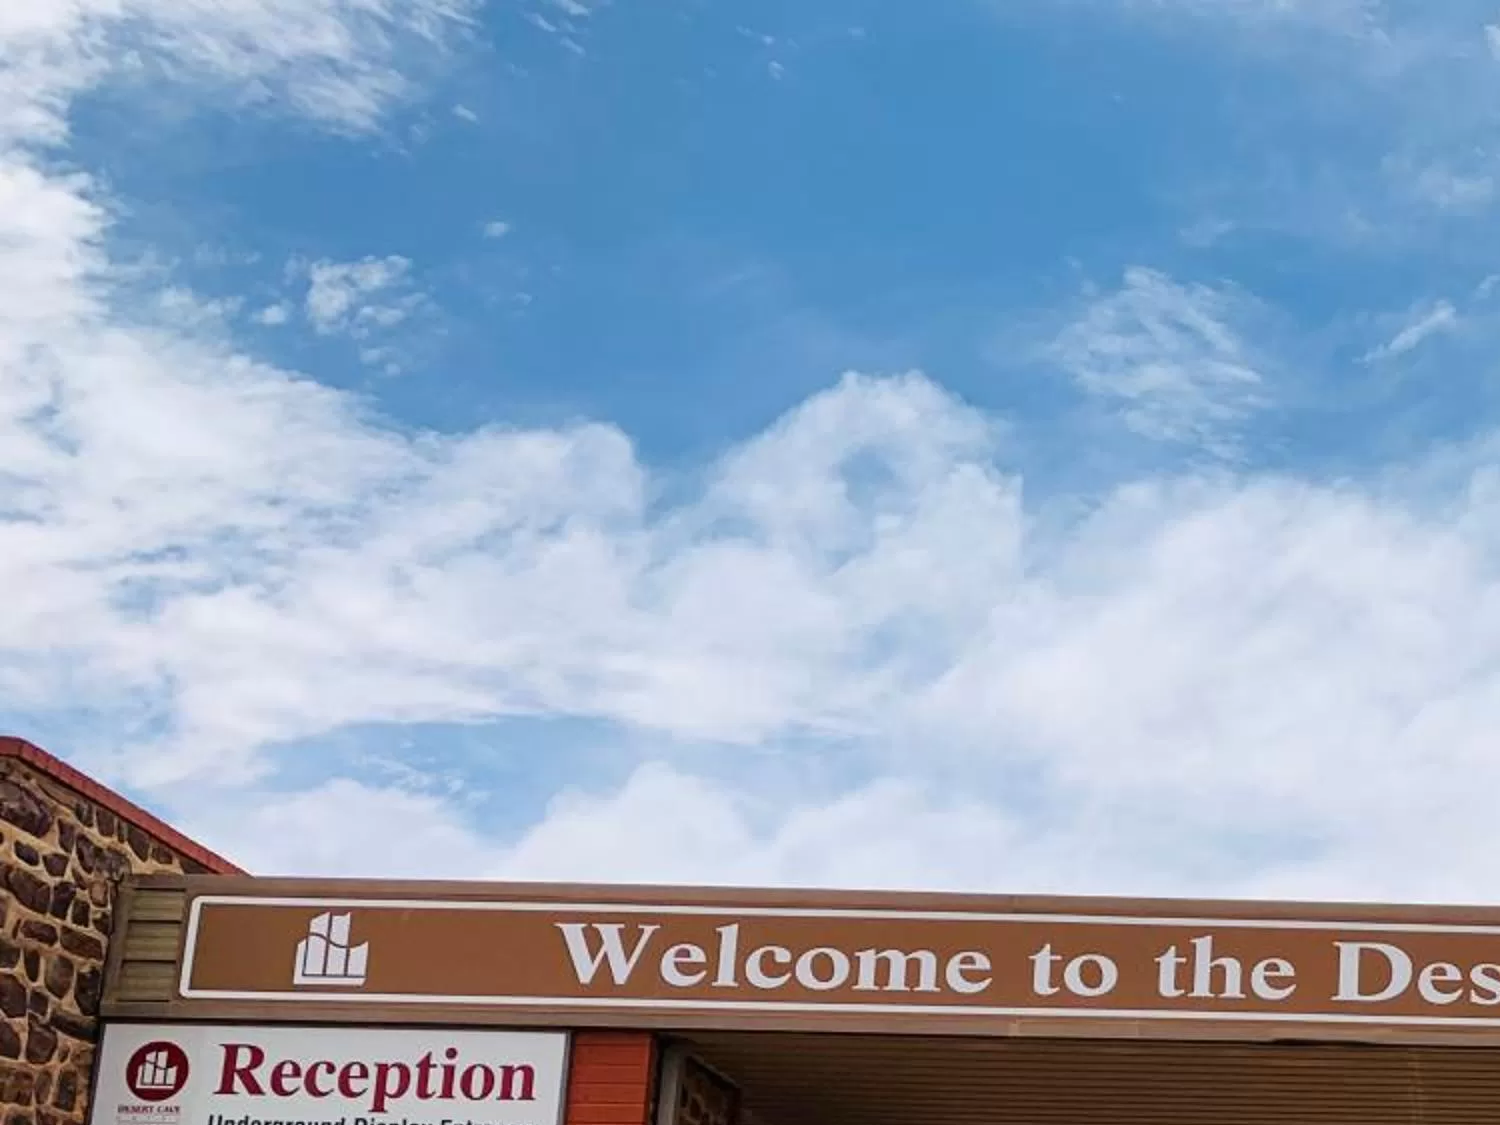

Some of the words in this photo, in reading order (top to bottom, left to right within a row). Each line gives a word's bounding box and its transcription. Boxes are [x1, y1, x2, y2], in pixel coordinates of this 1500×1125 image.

[553, 922, 993, 995] Welcome
[1029, 943, 1118, 997] to
[1154, 935, 1297, 1000] the
[213, 1043, 536, 1113] Reception
